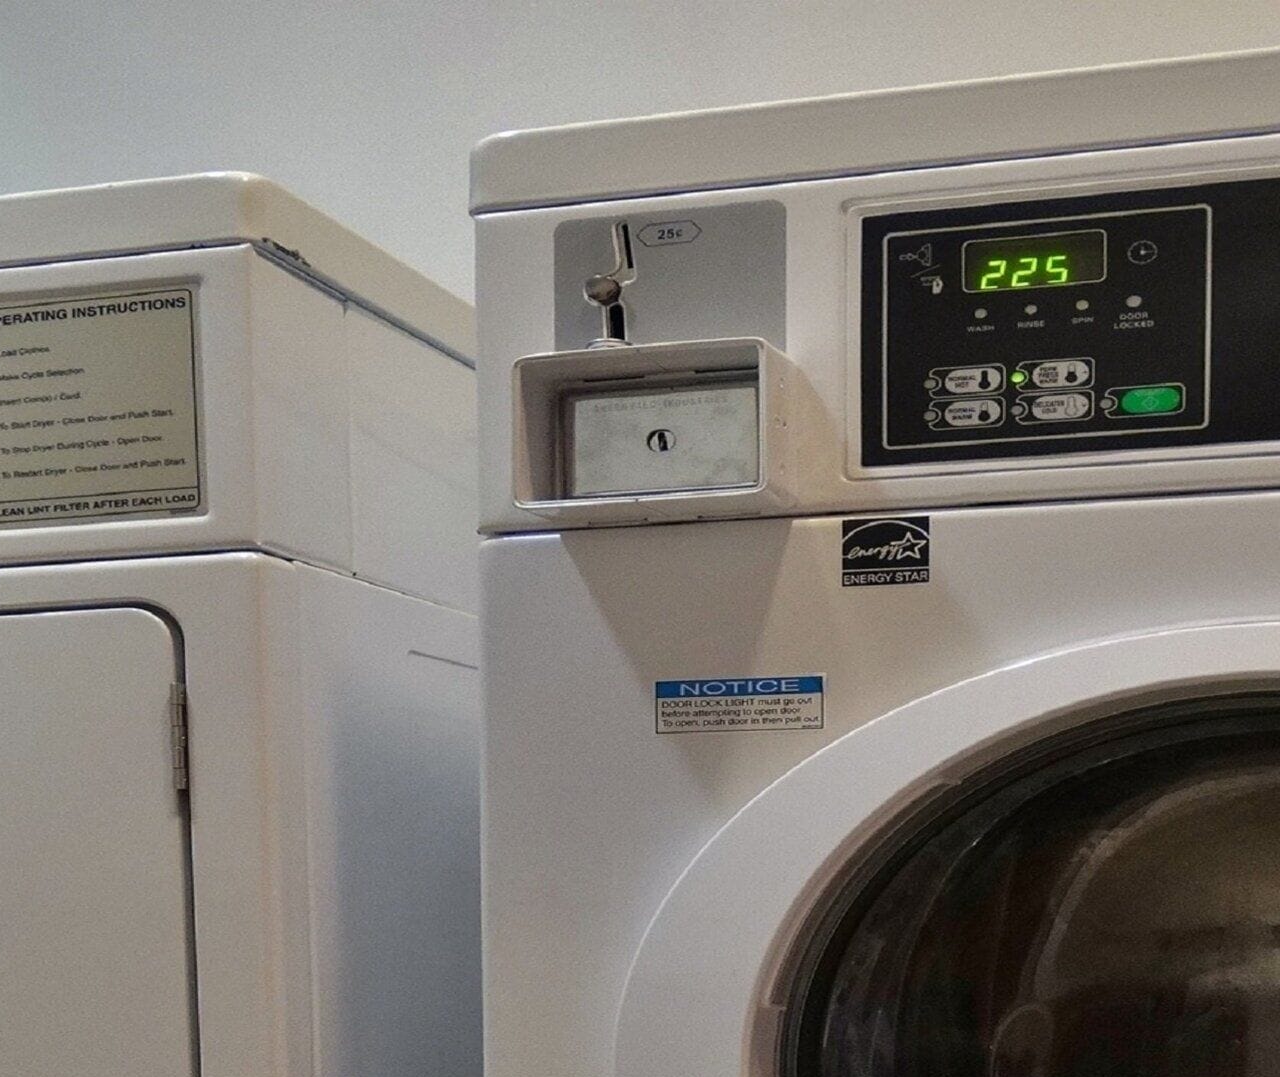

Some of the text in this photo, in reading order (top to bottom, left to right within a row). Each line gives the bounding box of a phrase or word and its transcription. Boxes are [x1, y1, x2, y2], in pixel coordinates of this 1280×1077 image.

[980, 255, 1069, 290] 225
[72, 296, 187, 318] INSTRUCTIONS
[1072, 316, 1095, 324] SPIN
[1119, 312, 1149, 320] DOOR
[966, 324, 995, 332] WASH
[1018, 320, 1045, 328] RINSE
[1114, 320, 1155, 330] LOCKED
[0, 422, 9, 430] To
[11, 422, 31, 430] Start
[32, 420, 55, 429] Dryer
[62, 417, 85, 425] Close
[128, 411, 149, 419] Push
[32, 445, 55, 453] Dryer
[56, 442, 84, 450] During
[86, 440, 109, 448] Cycle
[117, 437, 140, 445] Open
[2, 471, 11, 479] To
[13, 470, 42, 478] Restart
[45, 468, 67, 477] Dryer
[123, 461, 138, 469] and
[27, 505, 51, 515] LINT
[54, 502, 90, 513] FILTER
[93, 499, 128, 510] AFTER
[132, 497, 162, 507] EACH
[165, 494, 195, 504] LOAD
[848, 541, 901, 560] energy
[844, 571, 928, 585] ENERGY STAR
[679, 678, 800, 696] NOTICE
[661, 700, 692, 709] DOOR
[694, 699, 722, 708] LOCK
[725, 698, 755, 707] LIGHT
[758, 697, 780, 706] must
[782, 698, 794, 706] go
[661, 709, 690, 718] before
[692, 708, 740, 718] attempting
[743, 708, 751, 716] to
[754, 708, 777, 716] open
[662, 719, 673, 727] To
[702, 718, 726, 728] push
[728, 717, 749, 725] door
[751, 716, 760, 724] in
[762, 715, 783, 724] then
[785, 714, 801, 724] pull
